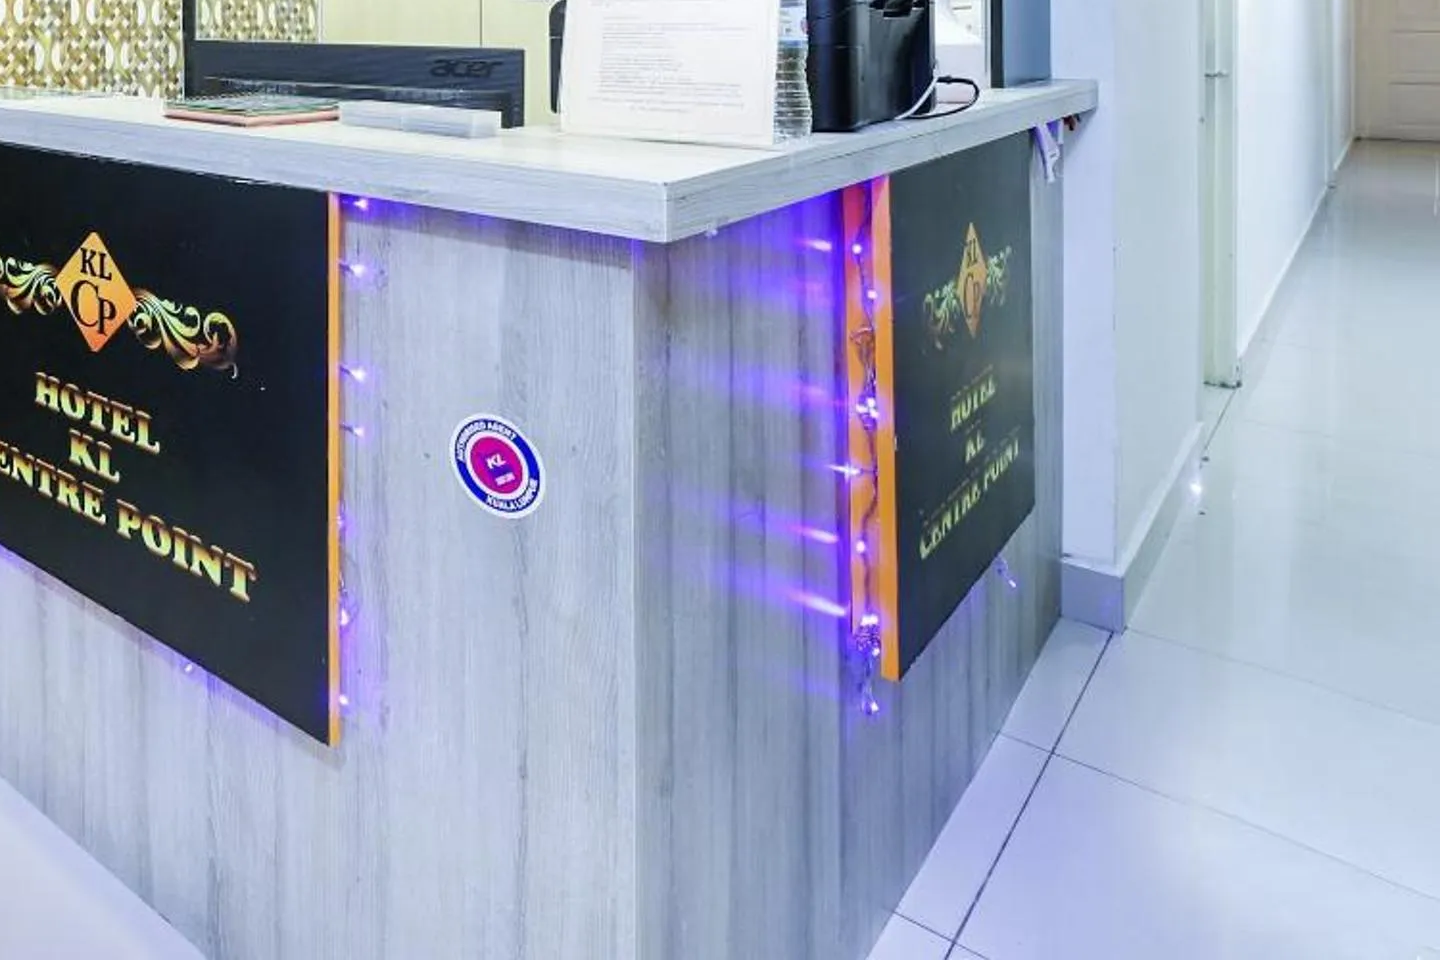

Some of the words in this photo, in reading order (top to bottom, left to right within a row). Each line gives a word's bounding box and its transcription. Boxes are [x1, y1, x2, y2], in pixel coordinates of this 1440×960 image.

[429, 59, 504, 78] acer
[80, 247, 112, 281] KL
[70, 279, 117, 337] CP
[35, 372, 161, 455] HOTEL
[68, 428, 121, 484] KL
[116, 498, 258, 603] POINT
